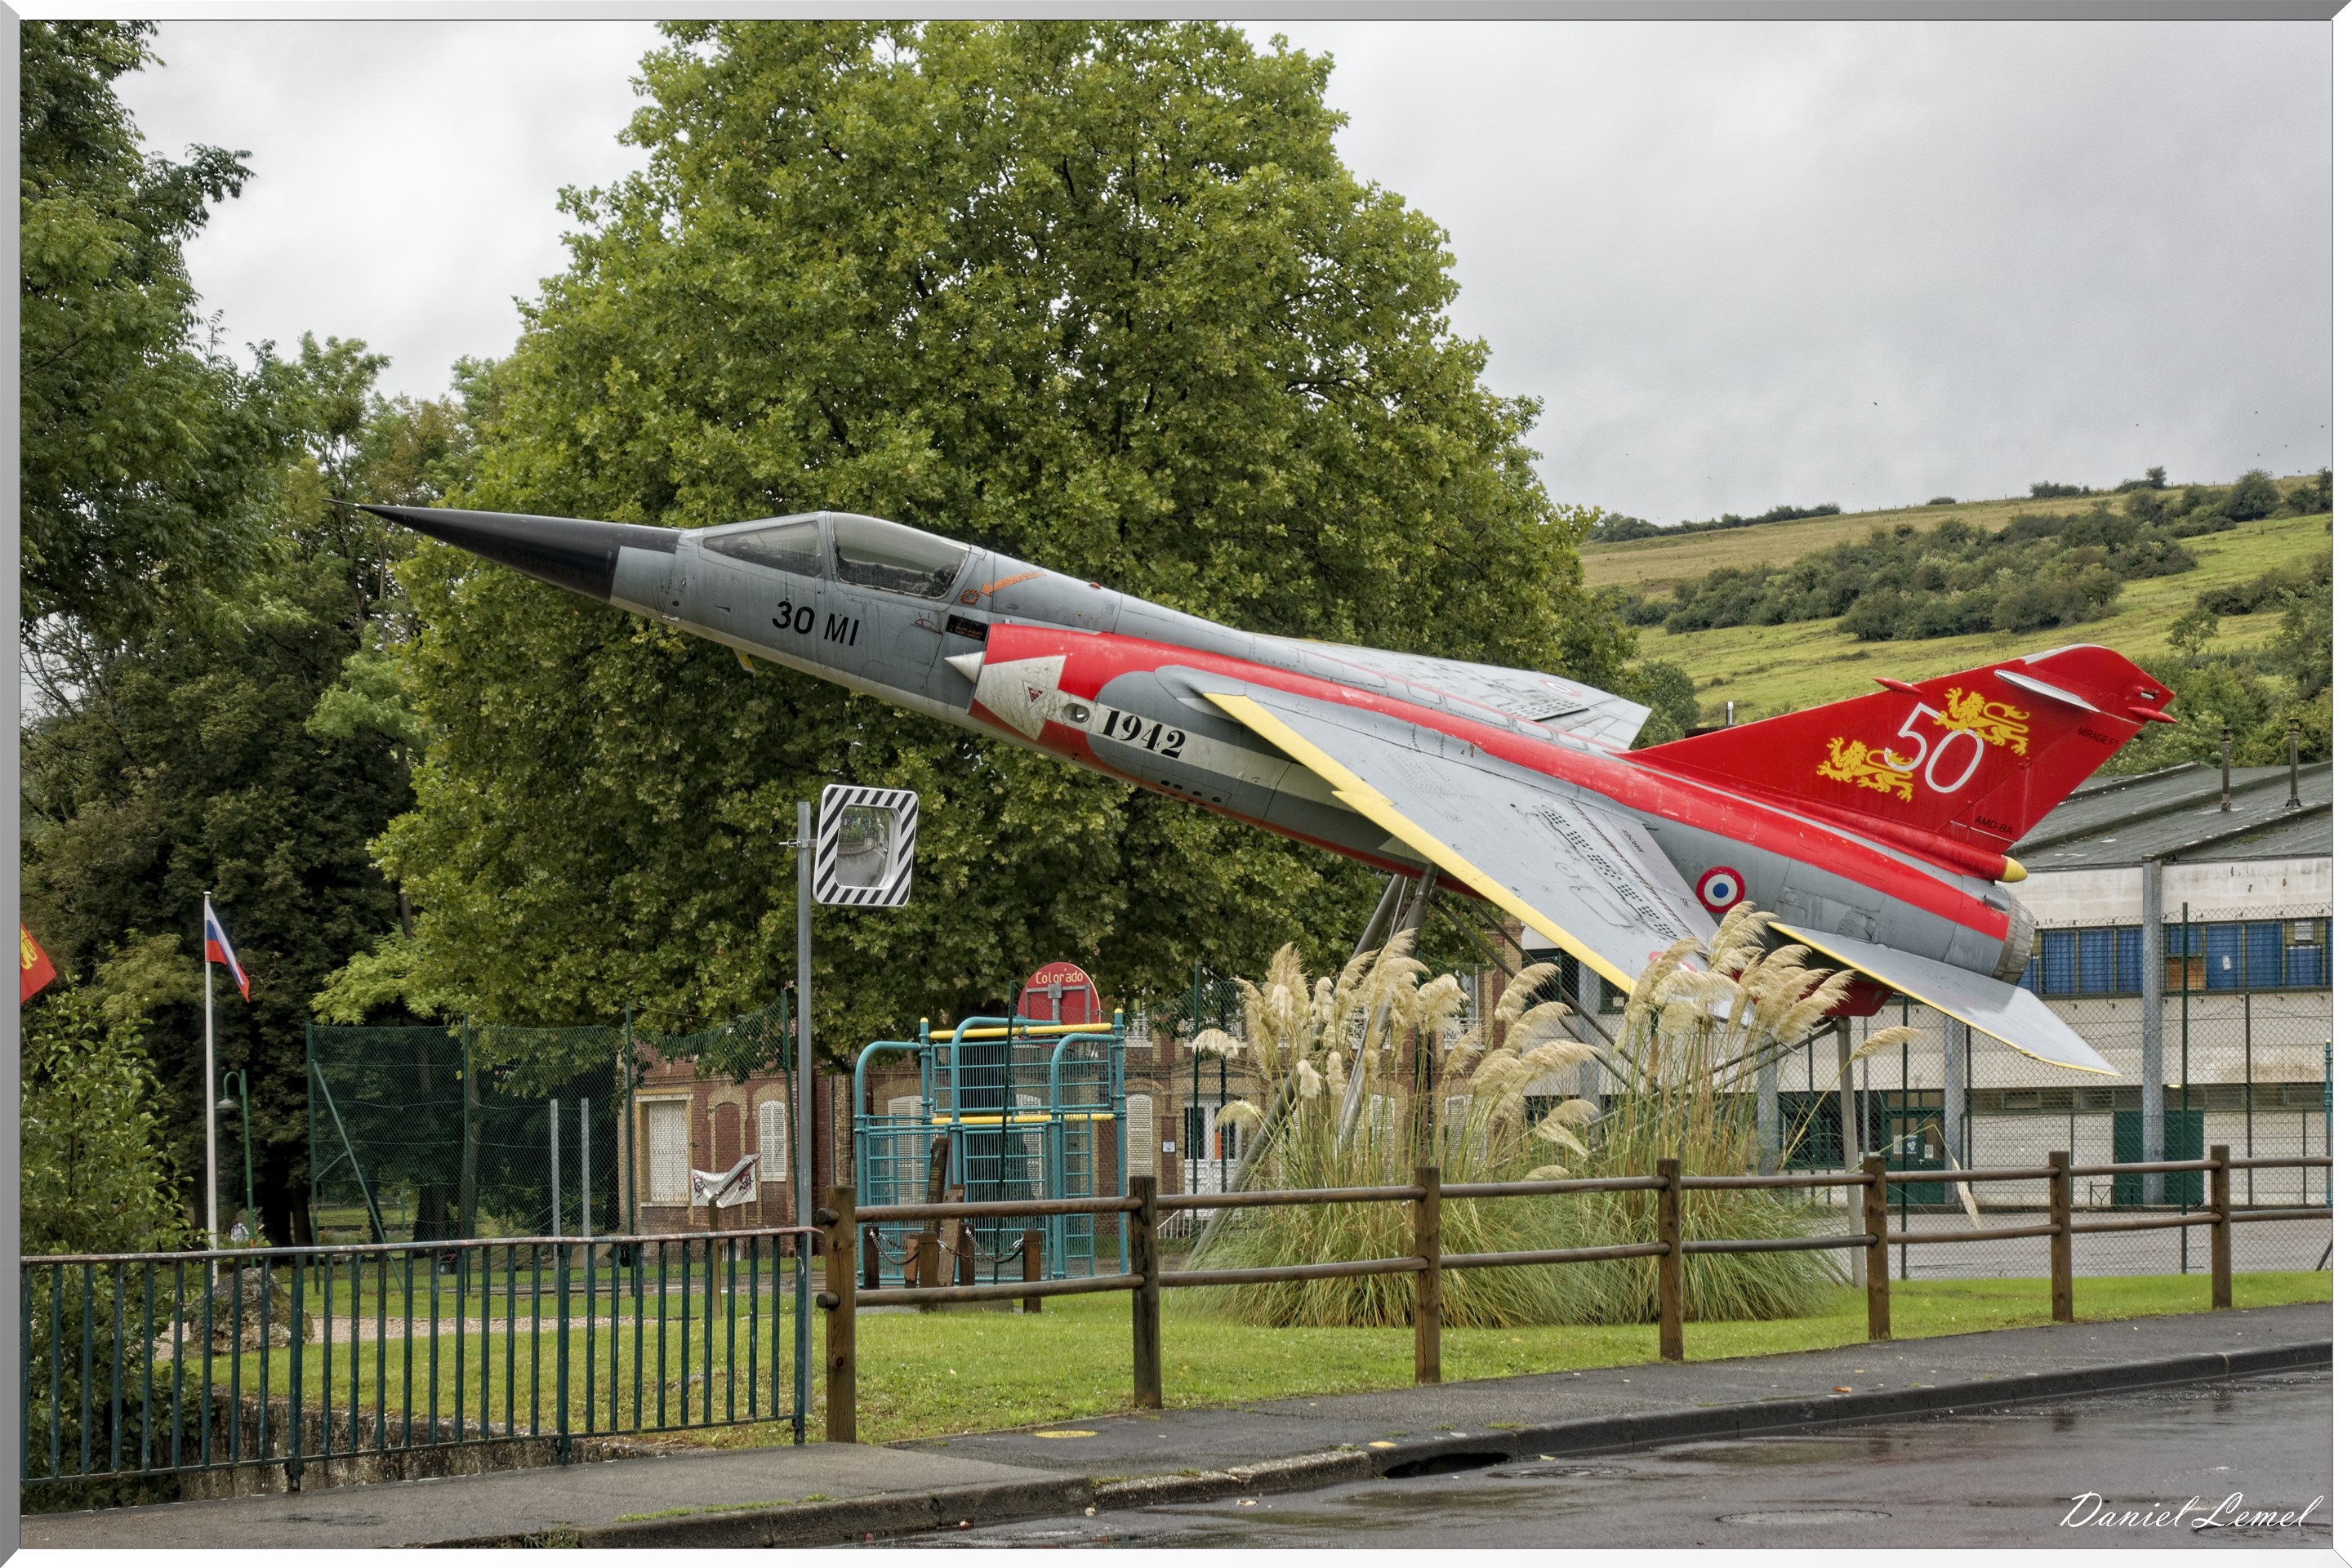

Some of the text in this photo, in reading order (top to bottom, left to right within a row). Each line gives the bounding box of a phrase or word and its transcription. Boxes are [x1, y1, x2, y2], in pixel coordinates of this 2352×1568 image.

[772, 600, 860, 647] 30 MI
[1098, 708, 1186, 760] 1942
[1883, 702, 1984, 794] 50
[2077, 726, 2119, 748] MIRAGE F1
[1973, 816, 2013, 835] AMD-BA
[1036, 971, 1084, 985] Colorado
